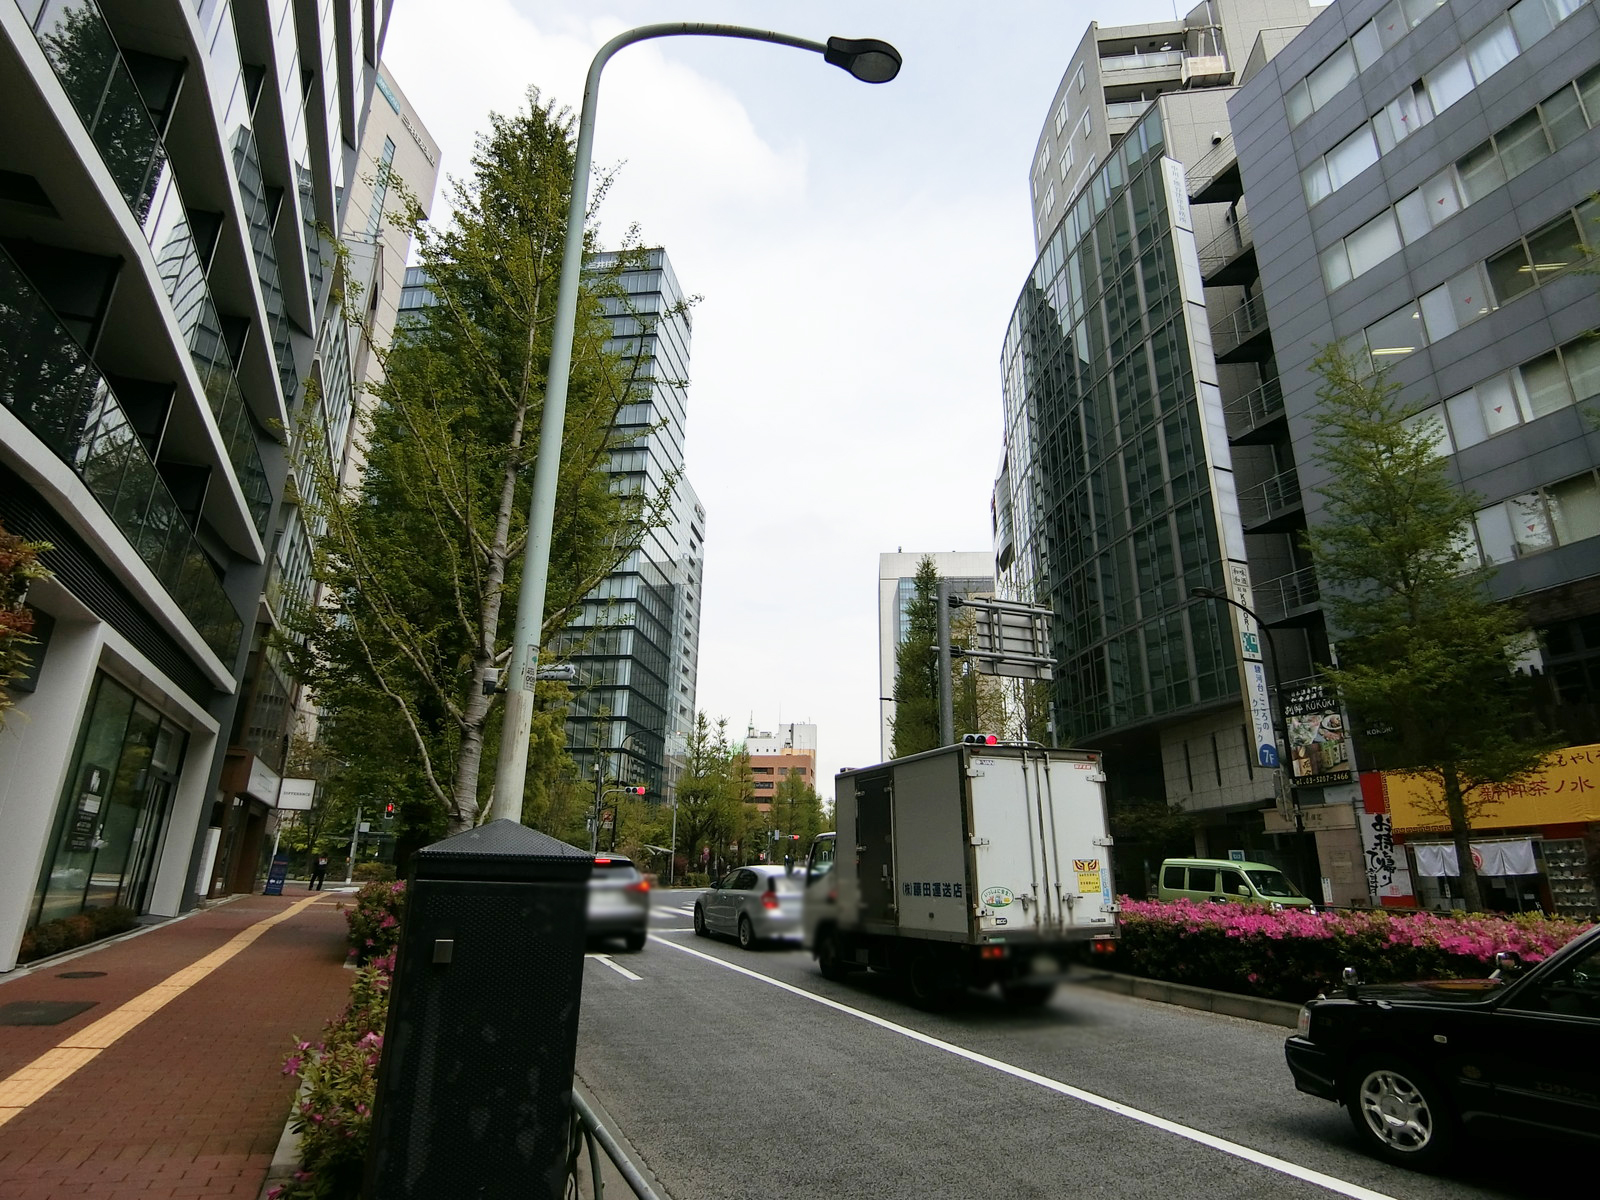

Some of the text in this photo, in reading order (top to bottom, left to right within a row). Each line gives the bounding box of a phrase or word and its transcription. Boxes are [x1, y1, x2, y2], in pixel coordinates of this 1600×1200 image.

[1240, 593, 1250, 631] KOORI
[1254, 664, 1270, 730] 駿河台こころの
[1252, 699, 1263, 742] クリニック
[1262, 749, 1275, 764] 7F
[1479, 775, 1595, 801] 新御茶ノ水
